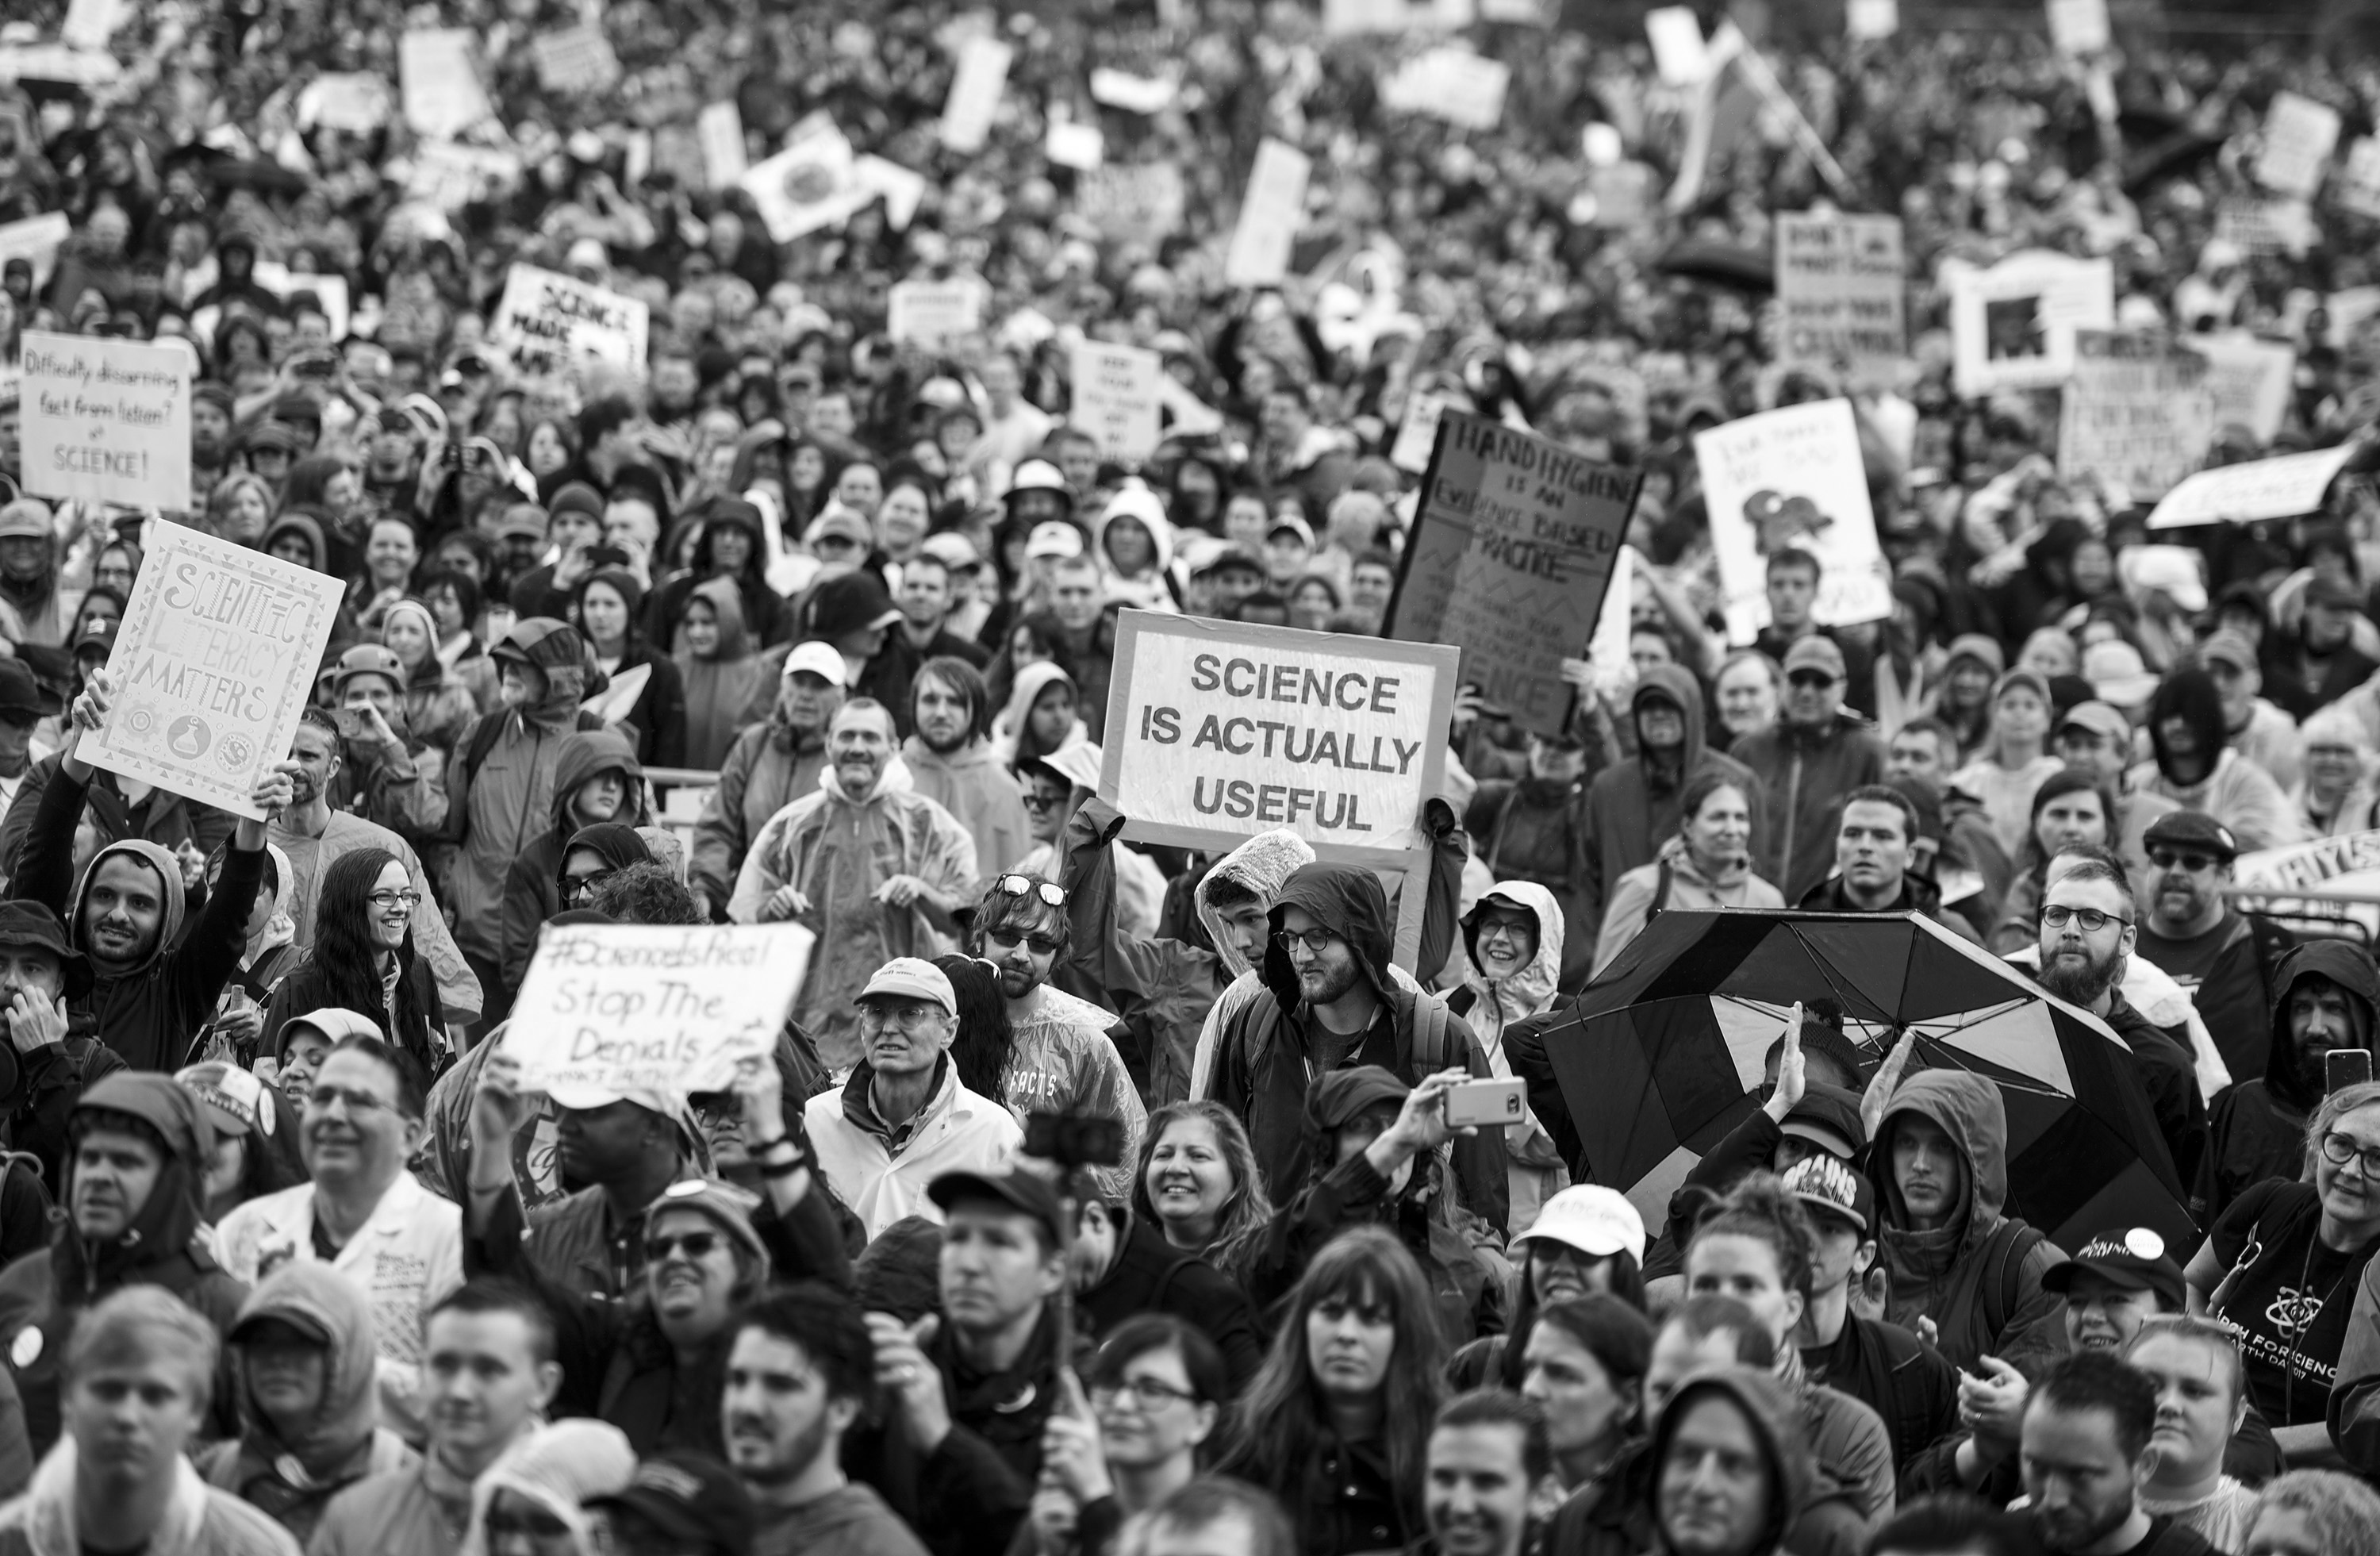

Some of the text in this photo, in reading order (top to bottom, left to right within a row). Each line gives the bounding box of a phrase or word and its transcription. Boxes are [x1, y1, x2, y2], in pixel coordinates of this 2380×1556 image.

[25, 348, 91, 388] Difficulty
[40, 390, 70, 416] fact
[75, 394, 113, 419] from
[1457, 421, 1537, 471] HAND
[1506, 475, 1565, 509] IS AN
[1534, 512, 1614, 553] BASED
[164, 563, 307, 644] SCIENTIFIC
[148, 609, 289, 682] LITERACY
[130, 653, 268, 723] MATTERS
[1191, 653, 1400, 714] SCIENCE
[1141, 705, 1422, 775] IS ACTUALLY
[1192, 775, 1372, 832] USEFUL
[551, 978, 725, 1027] Stop The
[570, 1026, 700, 1064] Denials
[1009, 1070, 1057, 1097] FACTS
[2225, 1335, 2307, 1380] ARTH DA 017
[2252, 1334, 2290, 1358] FOR
[2290, 1349, 2339, 1379] CIENC
